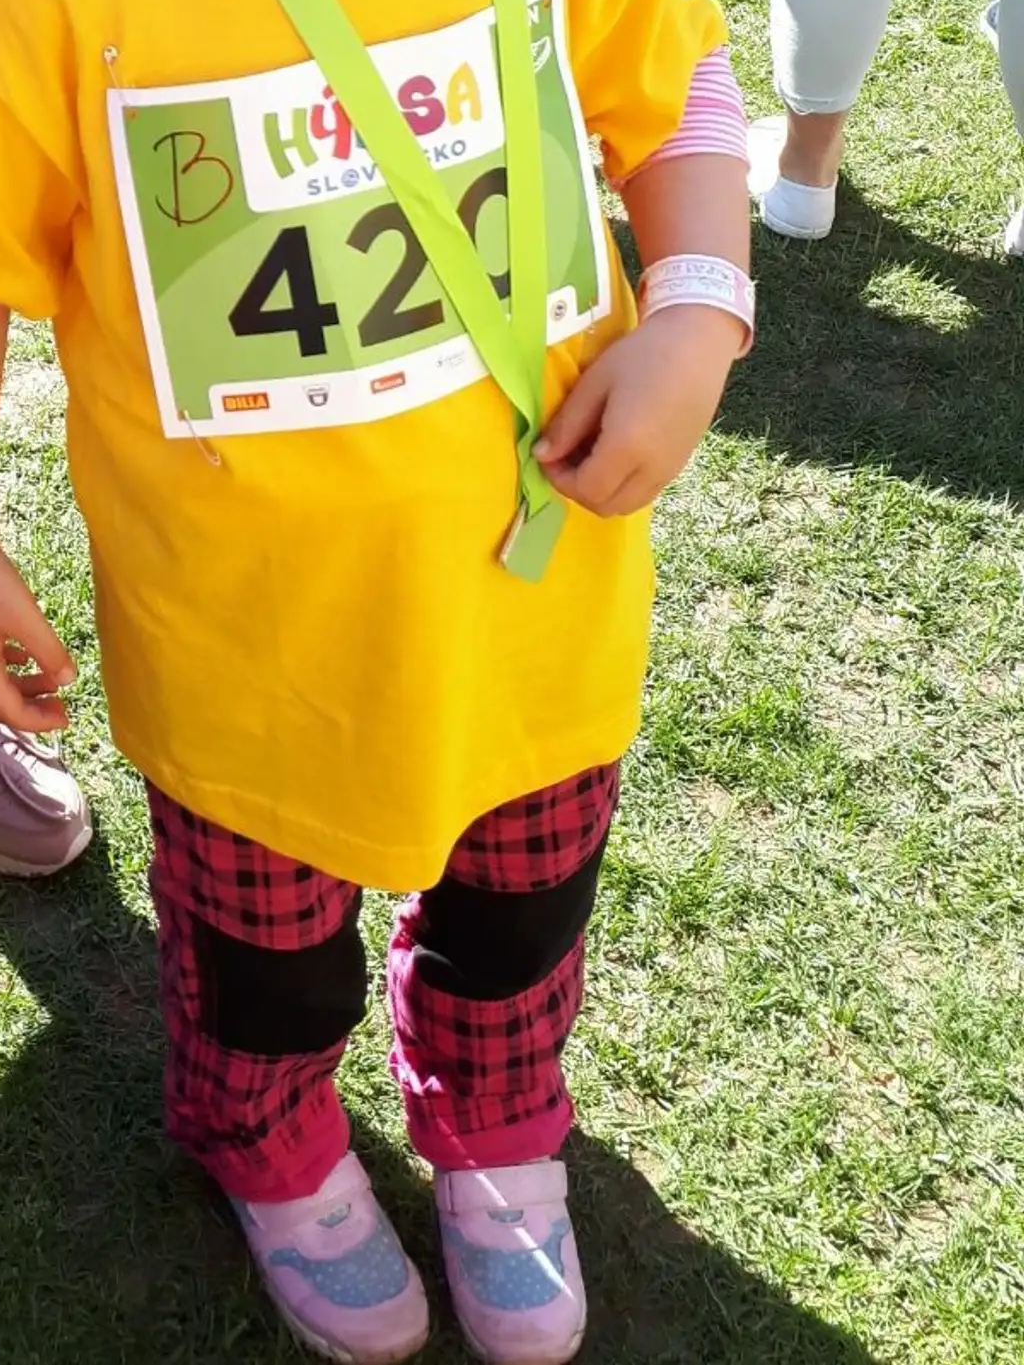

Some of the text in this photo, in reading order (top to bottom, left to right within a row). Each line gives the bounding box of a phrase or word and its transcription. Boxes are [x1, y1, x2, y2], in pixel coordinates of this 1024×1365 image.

[263, 61, 482, 180] HÝSA
[152, 130, 234, 228] B
[224, 393, 269, 412] BILLA
